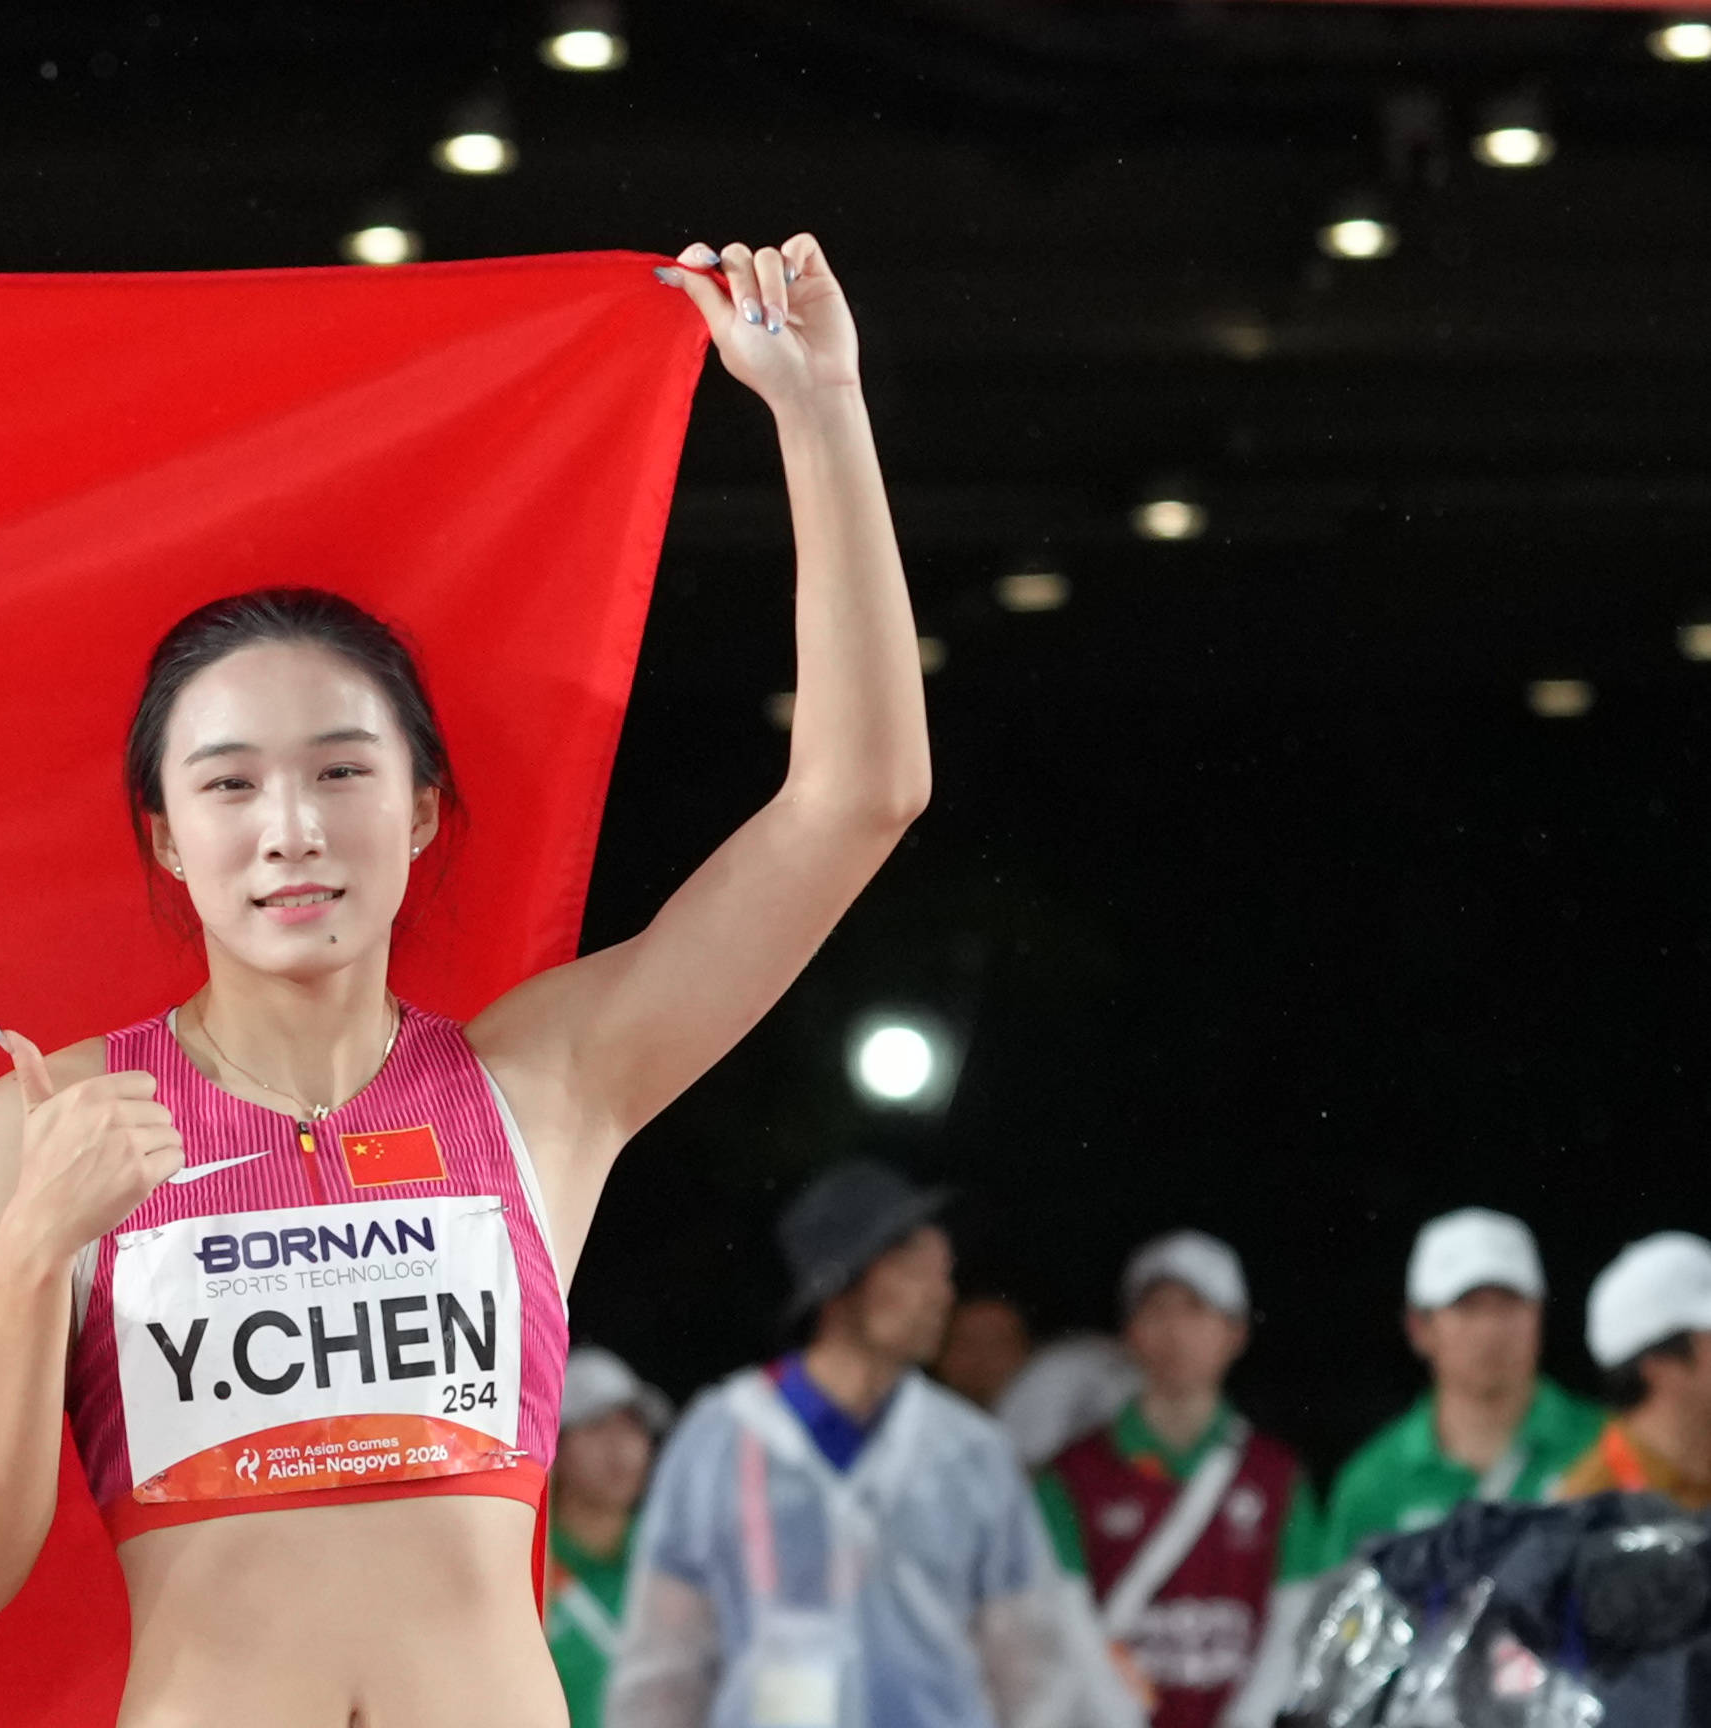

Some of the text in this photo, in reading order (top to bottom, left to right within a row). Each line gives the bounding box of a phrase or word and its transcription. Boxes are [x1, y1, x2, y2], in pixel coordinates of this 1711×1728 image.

[193, 1217, 435, 1274] BORNAN
[206, 1259, 439, 1299] SPORTS TECHNOLOGY
[145, 1290, 497, 1402] Y.CHEN
[443, 1381, 498, 1414] 254
[266, 1437, 399, 1461] 20th Asian Games
[268, 1444, 448, 1480] Aichi-Nagoya 2026
